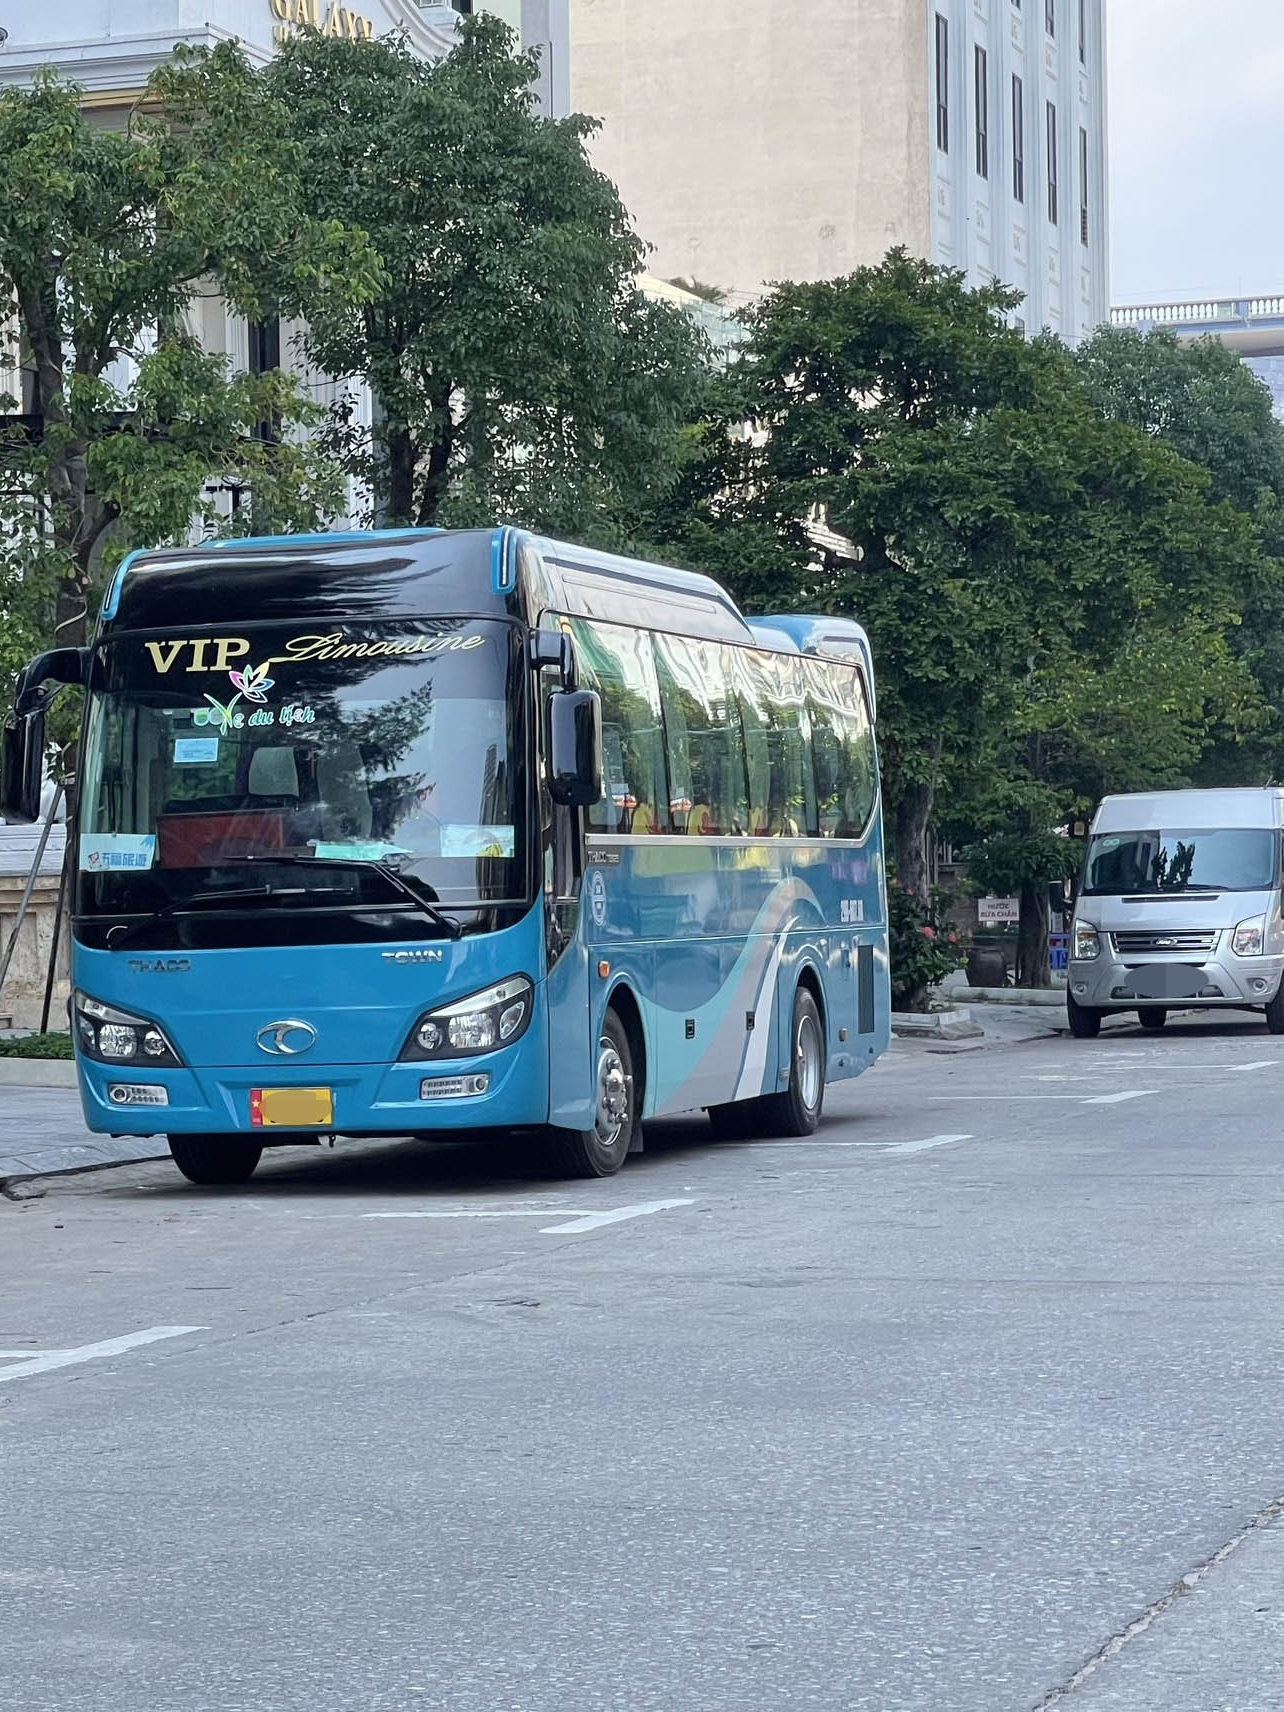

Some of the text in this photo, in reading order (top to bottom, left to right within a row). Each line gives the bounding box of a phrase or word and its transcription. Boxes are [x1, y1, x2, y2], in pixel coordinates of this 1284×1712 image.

[145, 632, 486, 673] VIP Limousine
[248, 708, 275, 726] du
[381, 949, 443, 965] TOWN
